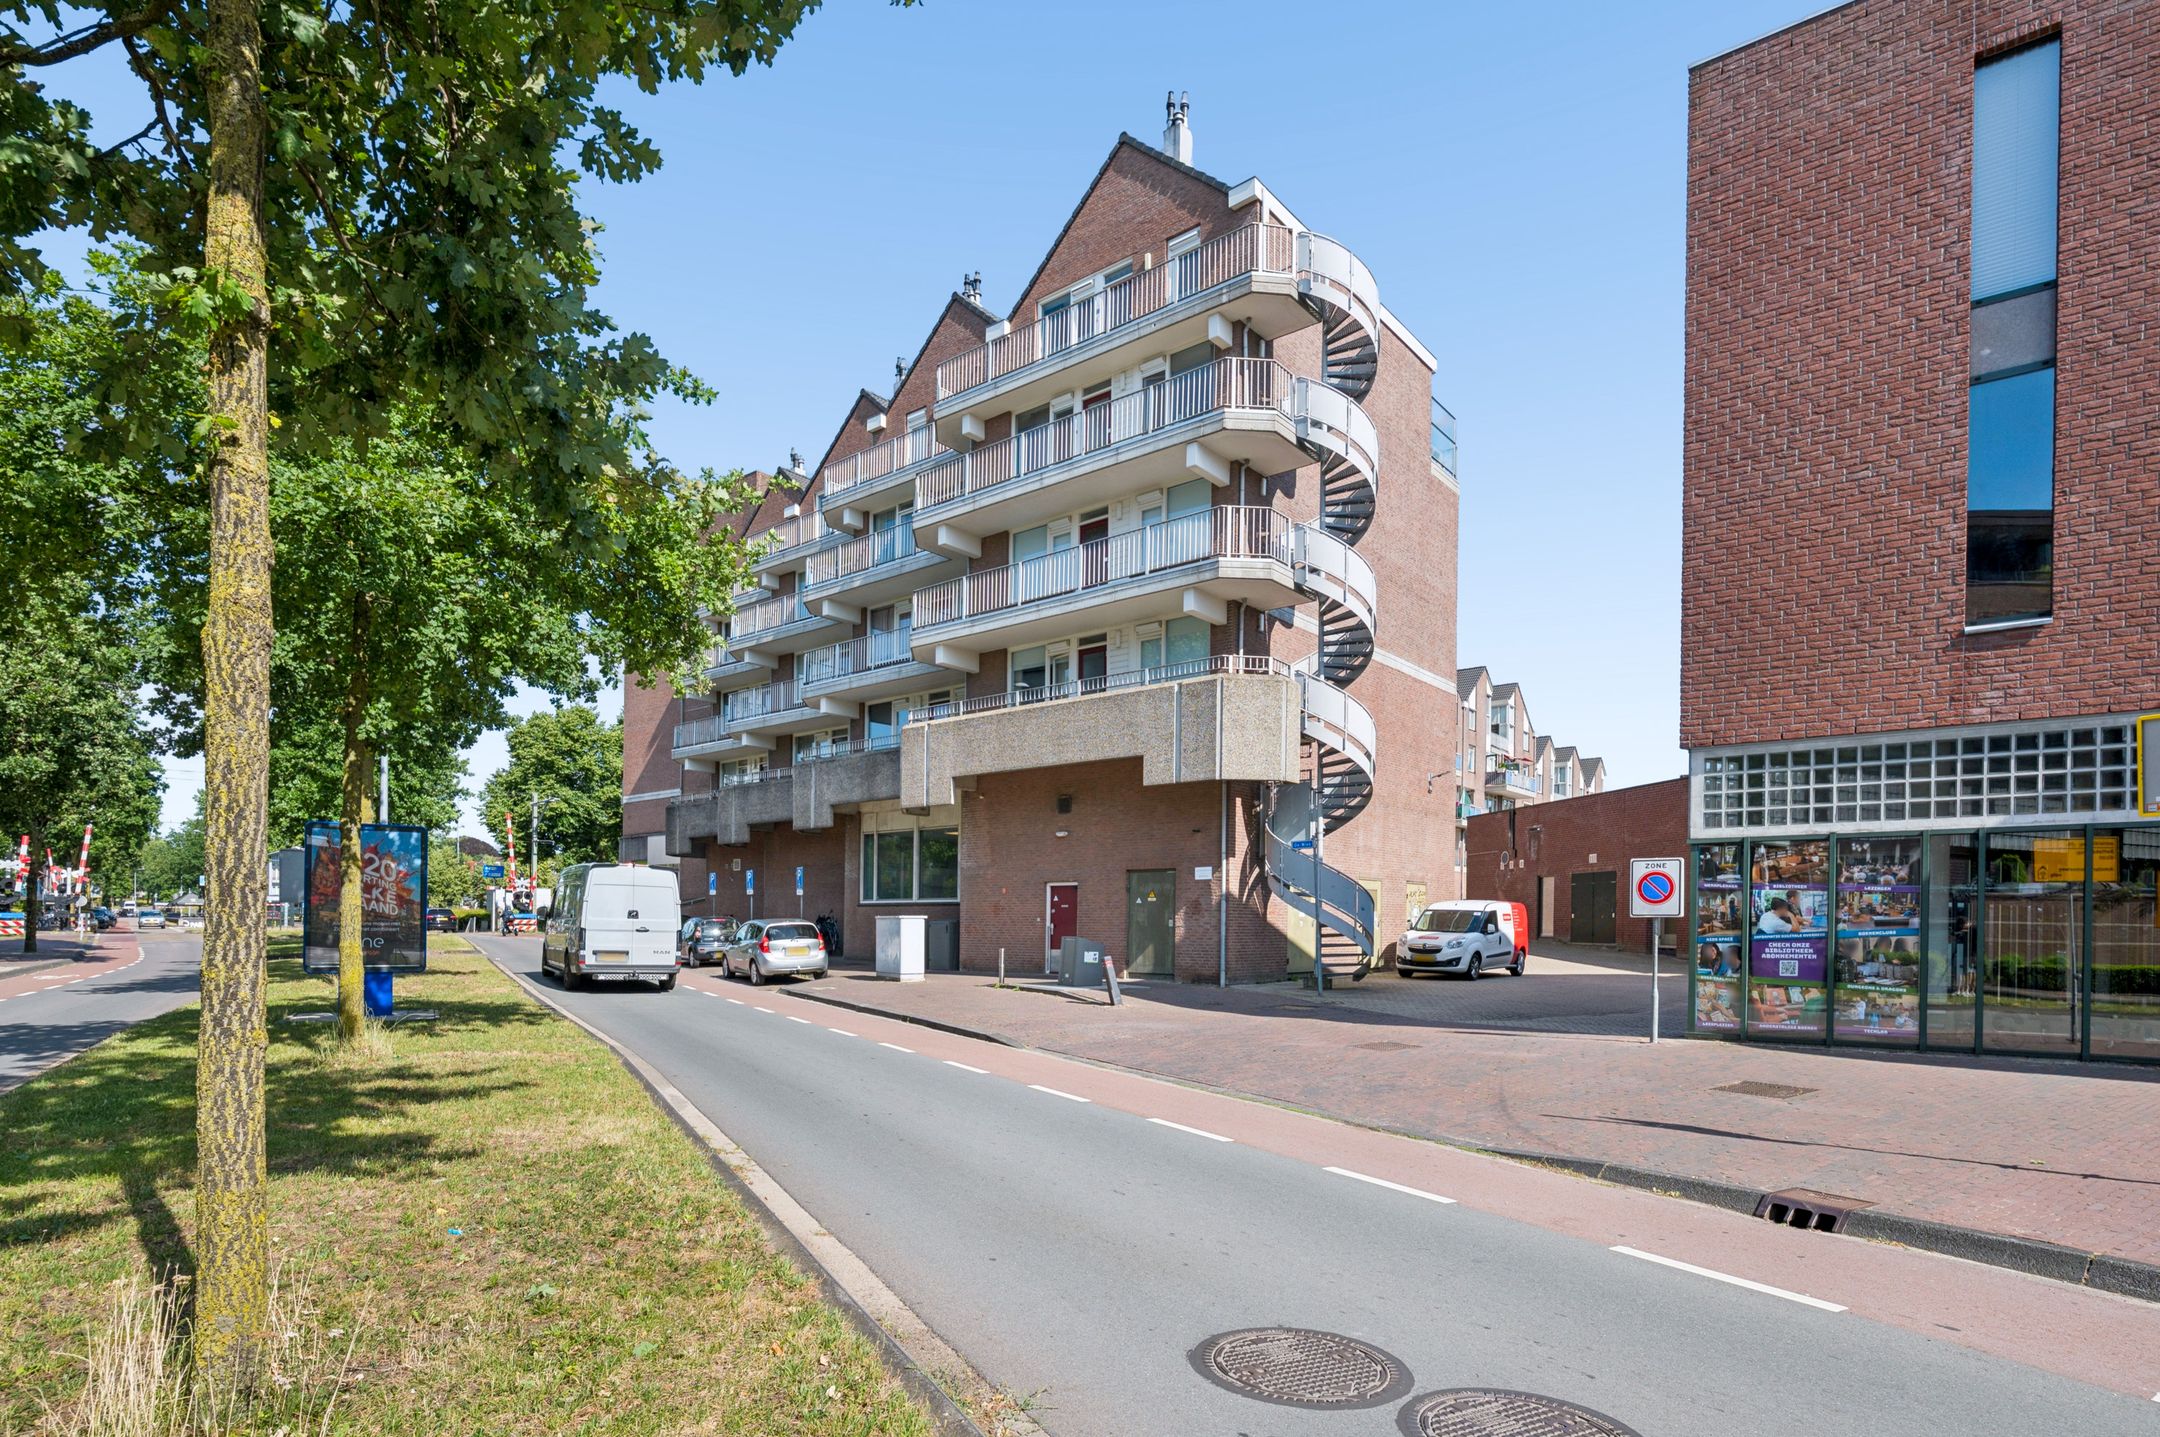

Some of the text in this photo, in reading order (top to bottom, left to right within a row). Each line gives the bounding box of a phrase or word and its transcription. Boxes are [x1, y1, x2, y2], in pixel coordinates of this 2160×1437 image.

[364, 853, 396, 881] 20
[363, 874, 397, 891] RTING
[361, 898, 399, 915] AAND
